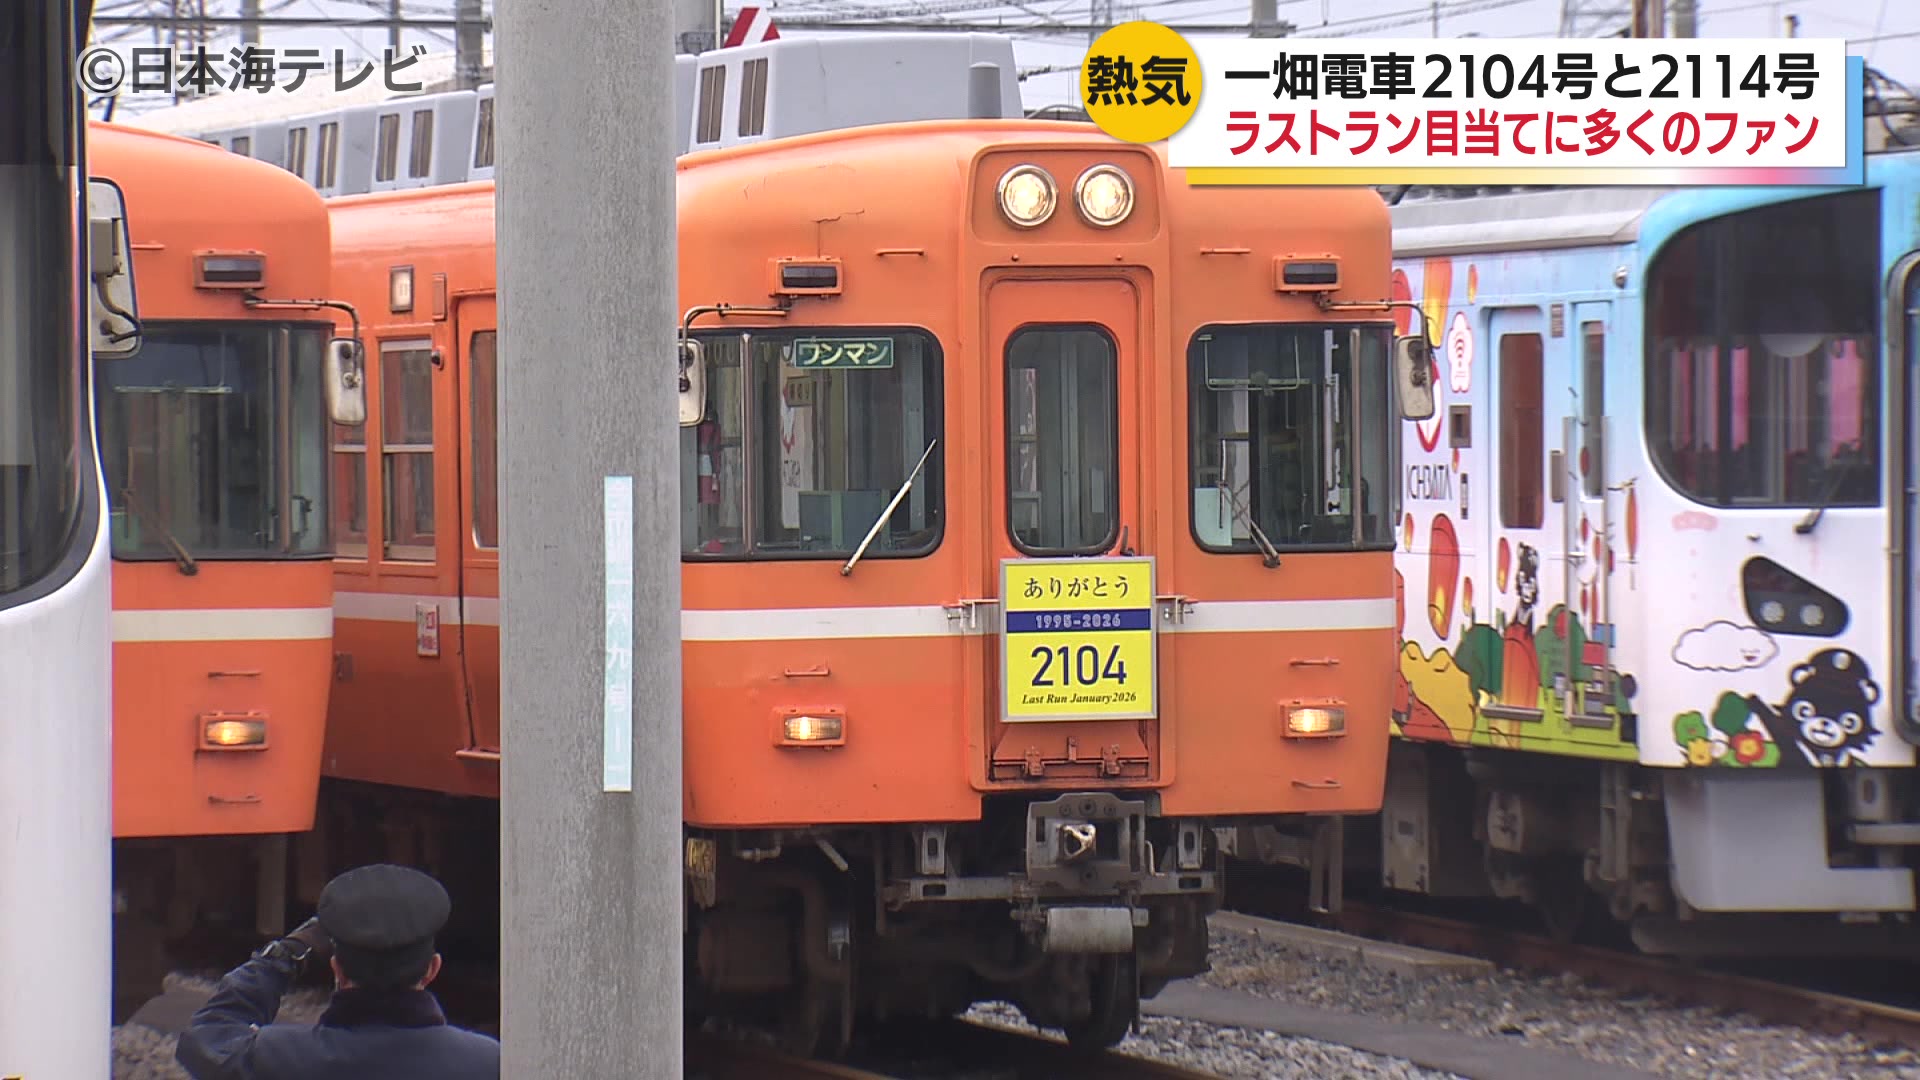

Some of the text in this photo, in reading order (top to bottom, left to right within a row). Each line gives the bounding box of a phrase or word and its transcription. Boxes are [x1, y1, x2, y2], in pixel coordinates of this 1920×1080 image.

[1023, 576, 1129, 598] ありがとう
[1035, 613, 1121, 629] 1995-2026
[1031, 645, 1127, 687] 2104
[1022, 694, 1044, 705] Last
[1046, 693, 1068, 704] Run
